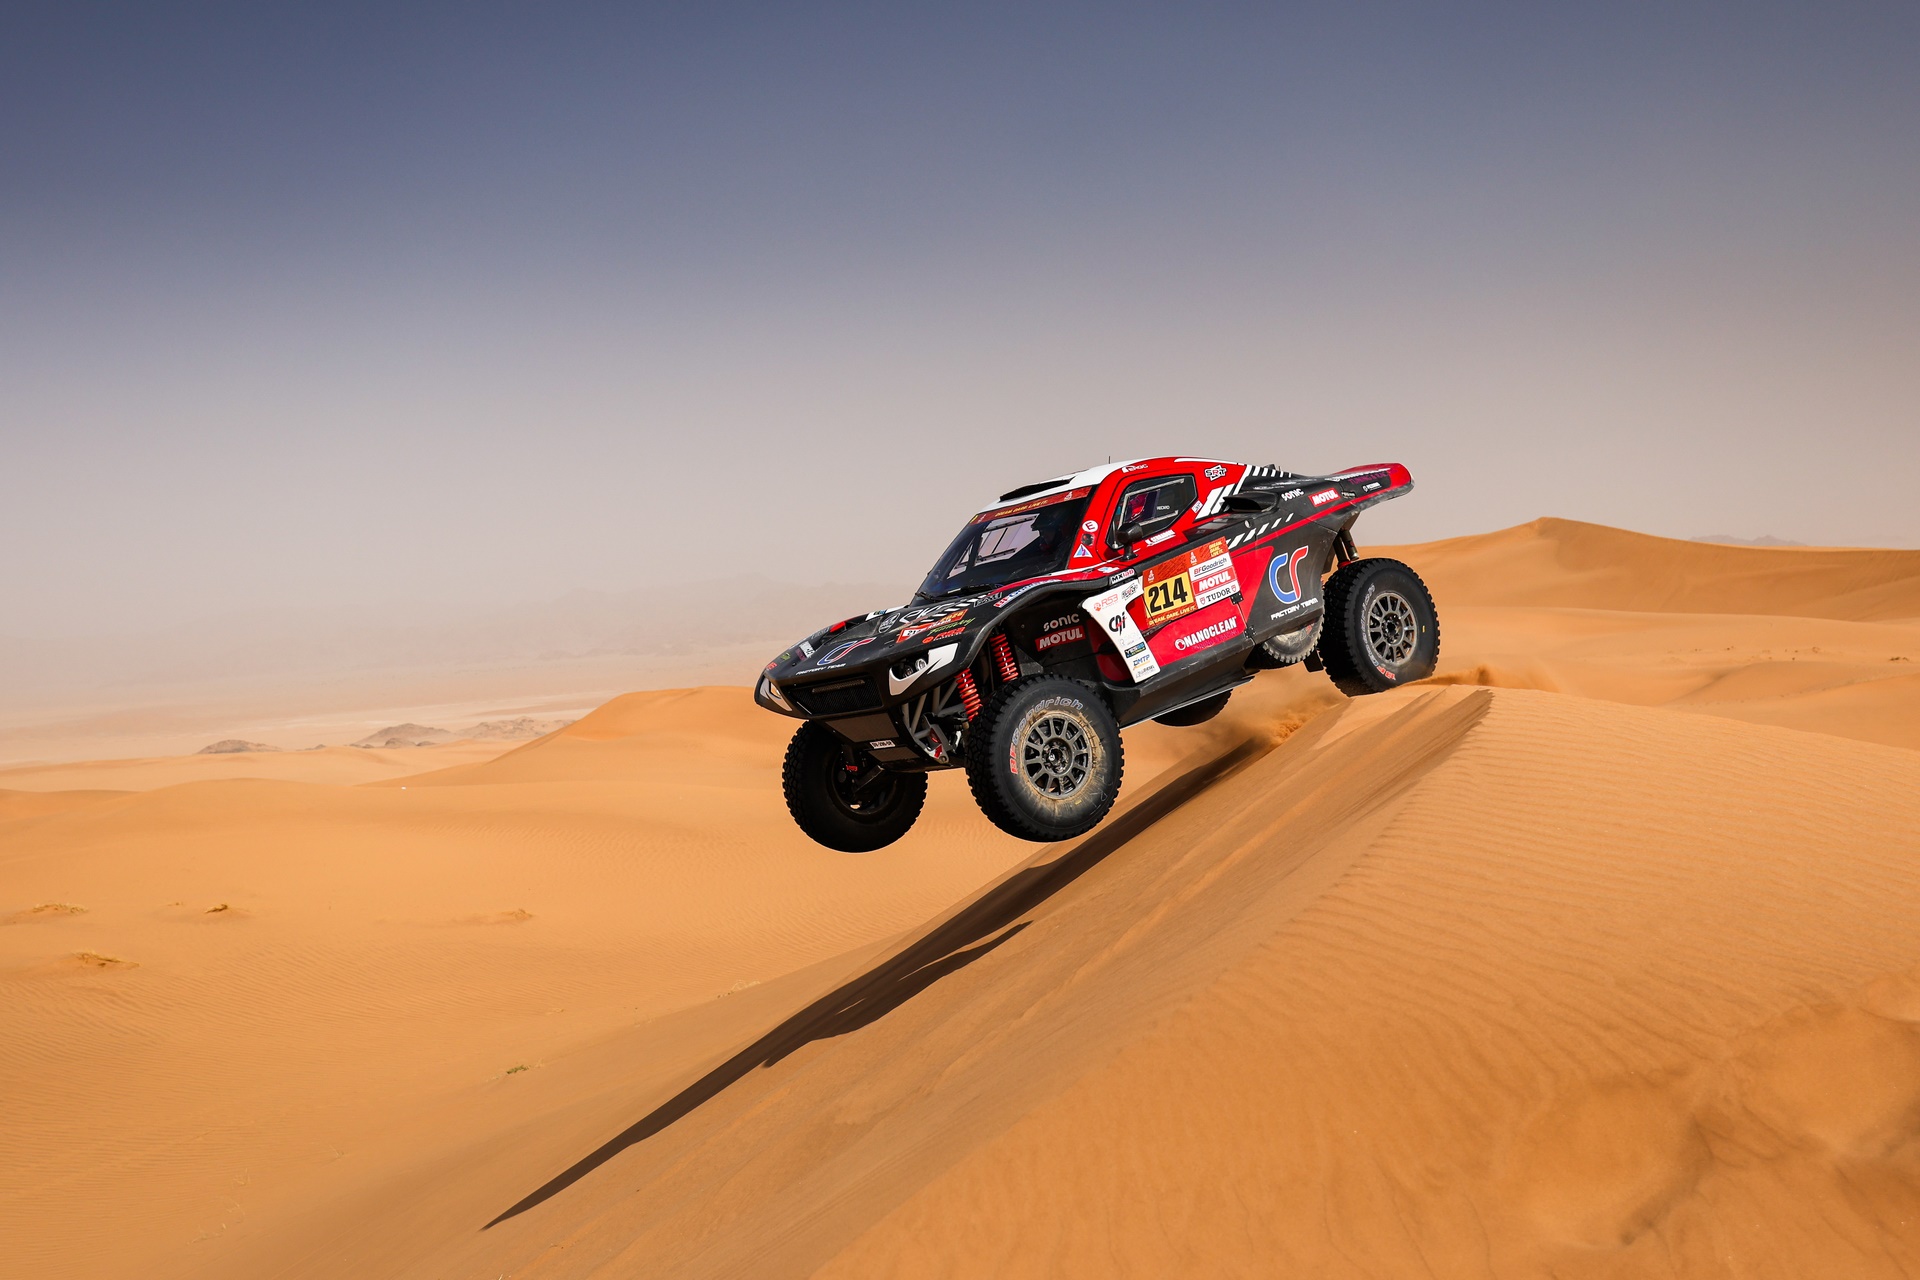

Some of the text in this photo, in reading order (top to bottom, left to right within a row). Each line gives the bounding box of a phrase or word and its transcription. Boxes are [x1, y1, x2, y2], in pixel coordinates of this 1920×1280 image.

[1311, 488, 1339, 505] MOTUL
[1193, 557, 1227, 575] BFGoodrich
[1199, 571, 1231, 592] MOTUL
[1148, 577, 1188, 613] 214
[1206, 587, 1232, 602] TUDOR
[1270, 597, 1318, 621] FACTORY TEAM
[1040, 628, 1083, 649] MOTUL
[1183, 616, 1238, 648] NANOCLEAN
